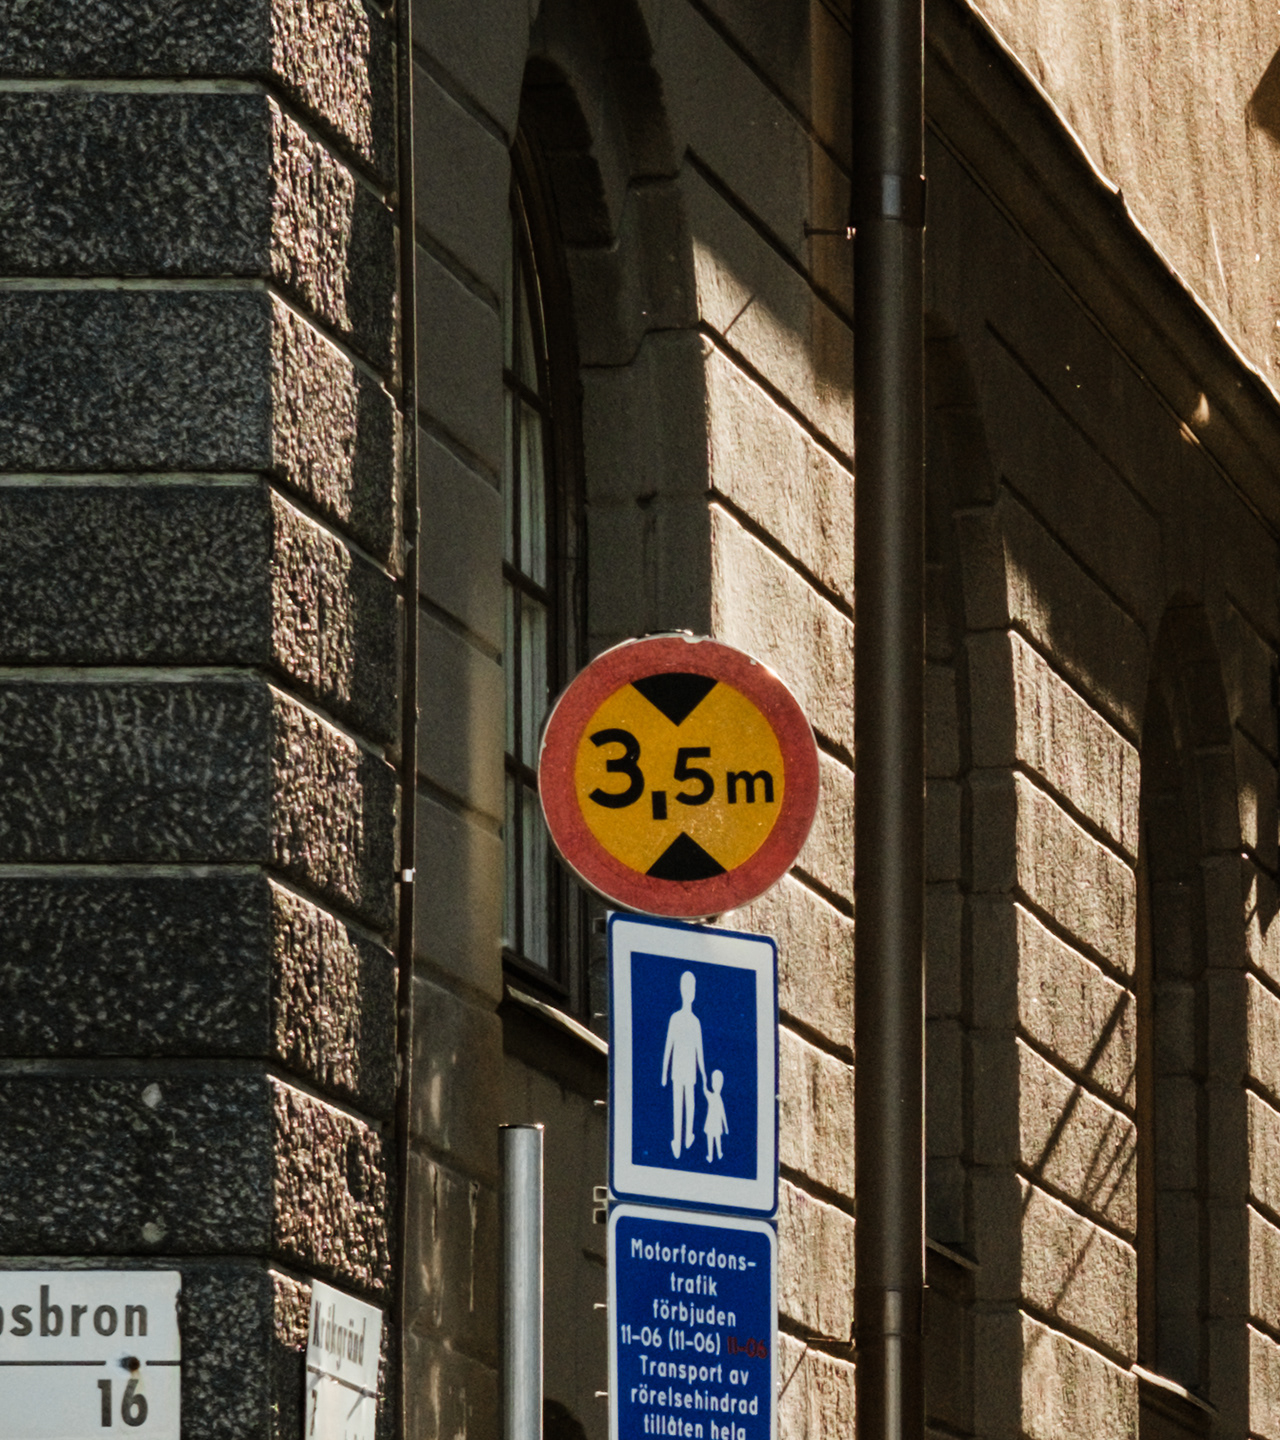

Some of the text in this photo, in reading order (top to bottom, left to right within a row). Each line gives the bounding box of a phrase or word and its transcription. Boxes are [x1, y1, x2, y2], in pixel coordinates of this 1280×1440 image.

[631, 1237, 757, 1271] Motorfordons-
[670, 1271, 718, 1297] trafik
[0, 1285, 148, 1337] sbron
[652, 1298, 737, 1328] förbjuden
[620, 1324, 768, 1359] 11-06 (11-06) 11-06
[639, 1354, 749, 1386] Transport av
[97, 1378, 149, 1428] 16
[631, 1383, 758, 1416] rörelsehindrad
[643, 1413, 704, 1439] tillåten
